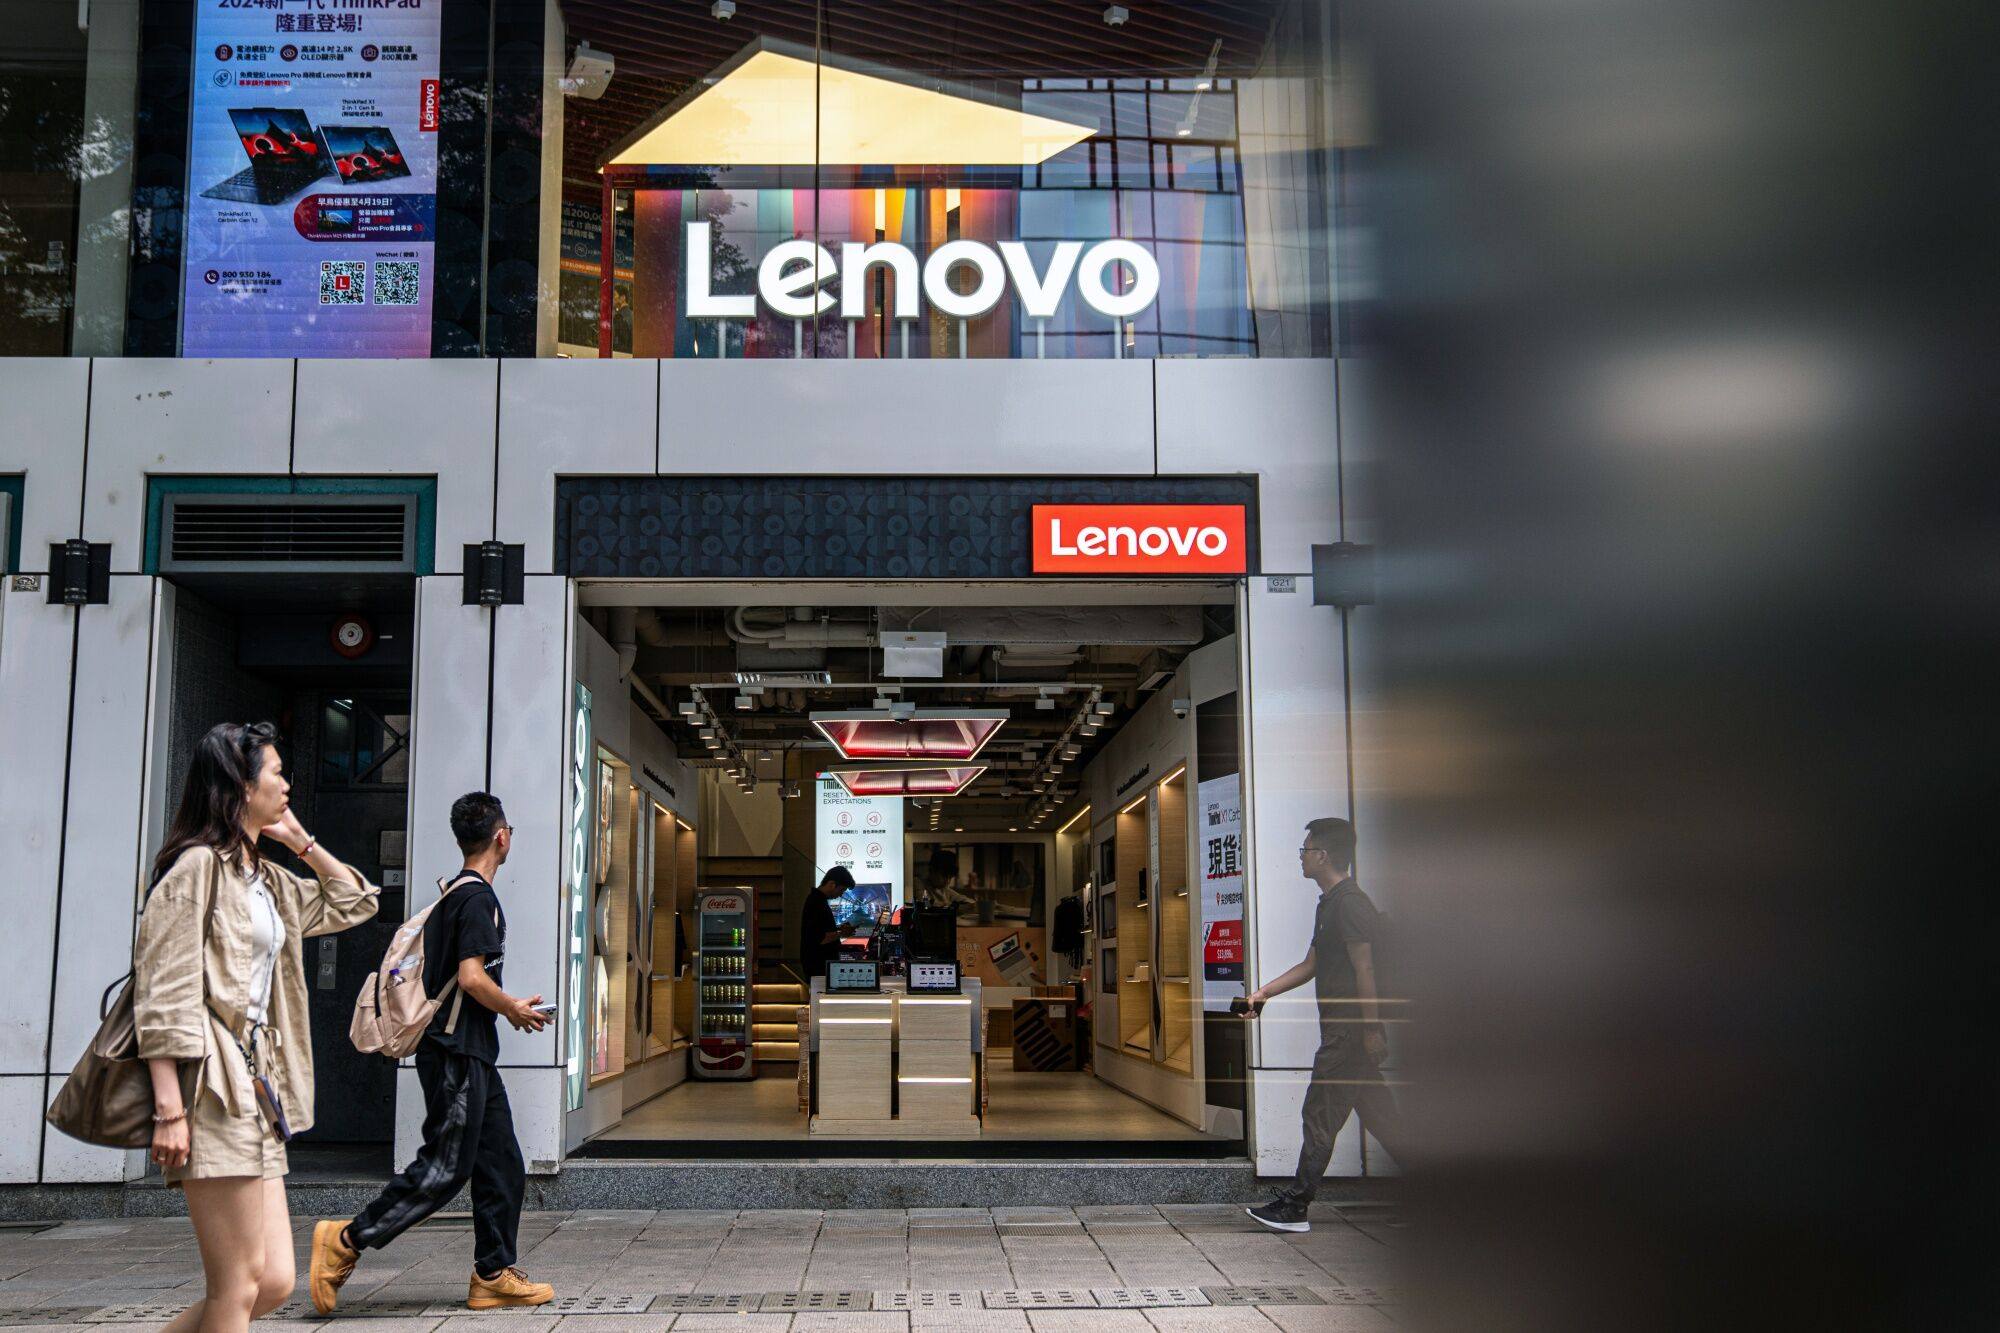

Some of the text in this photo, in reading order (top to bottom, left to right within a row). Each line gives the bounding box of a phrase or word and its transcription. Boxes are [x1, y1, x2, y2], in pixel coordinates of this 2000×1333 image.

[276, 13, 363, 33] 隆重登場!
[266, 71, 290, 79] Lenovo
[290, 71, 302, 79] Pro
[322, 71, 346, 79] Lenovo
[423, 83, 435, 128] Lenovo
[317, 198, 393, 206] 早鳥優惠至4月19日!
[256, 271, 272, 279] 184
[686, 222, 1160, 318] Lenovo
[1051, 518, 1228, 557] Lenovo
[1272, 579, 1289, 587] G21
[1207, 802, 1220, 812] Lenovo
[392, 873, 399, 883] 2
[568, 708, 586, 1077] Lenovo
